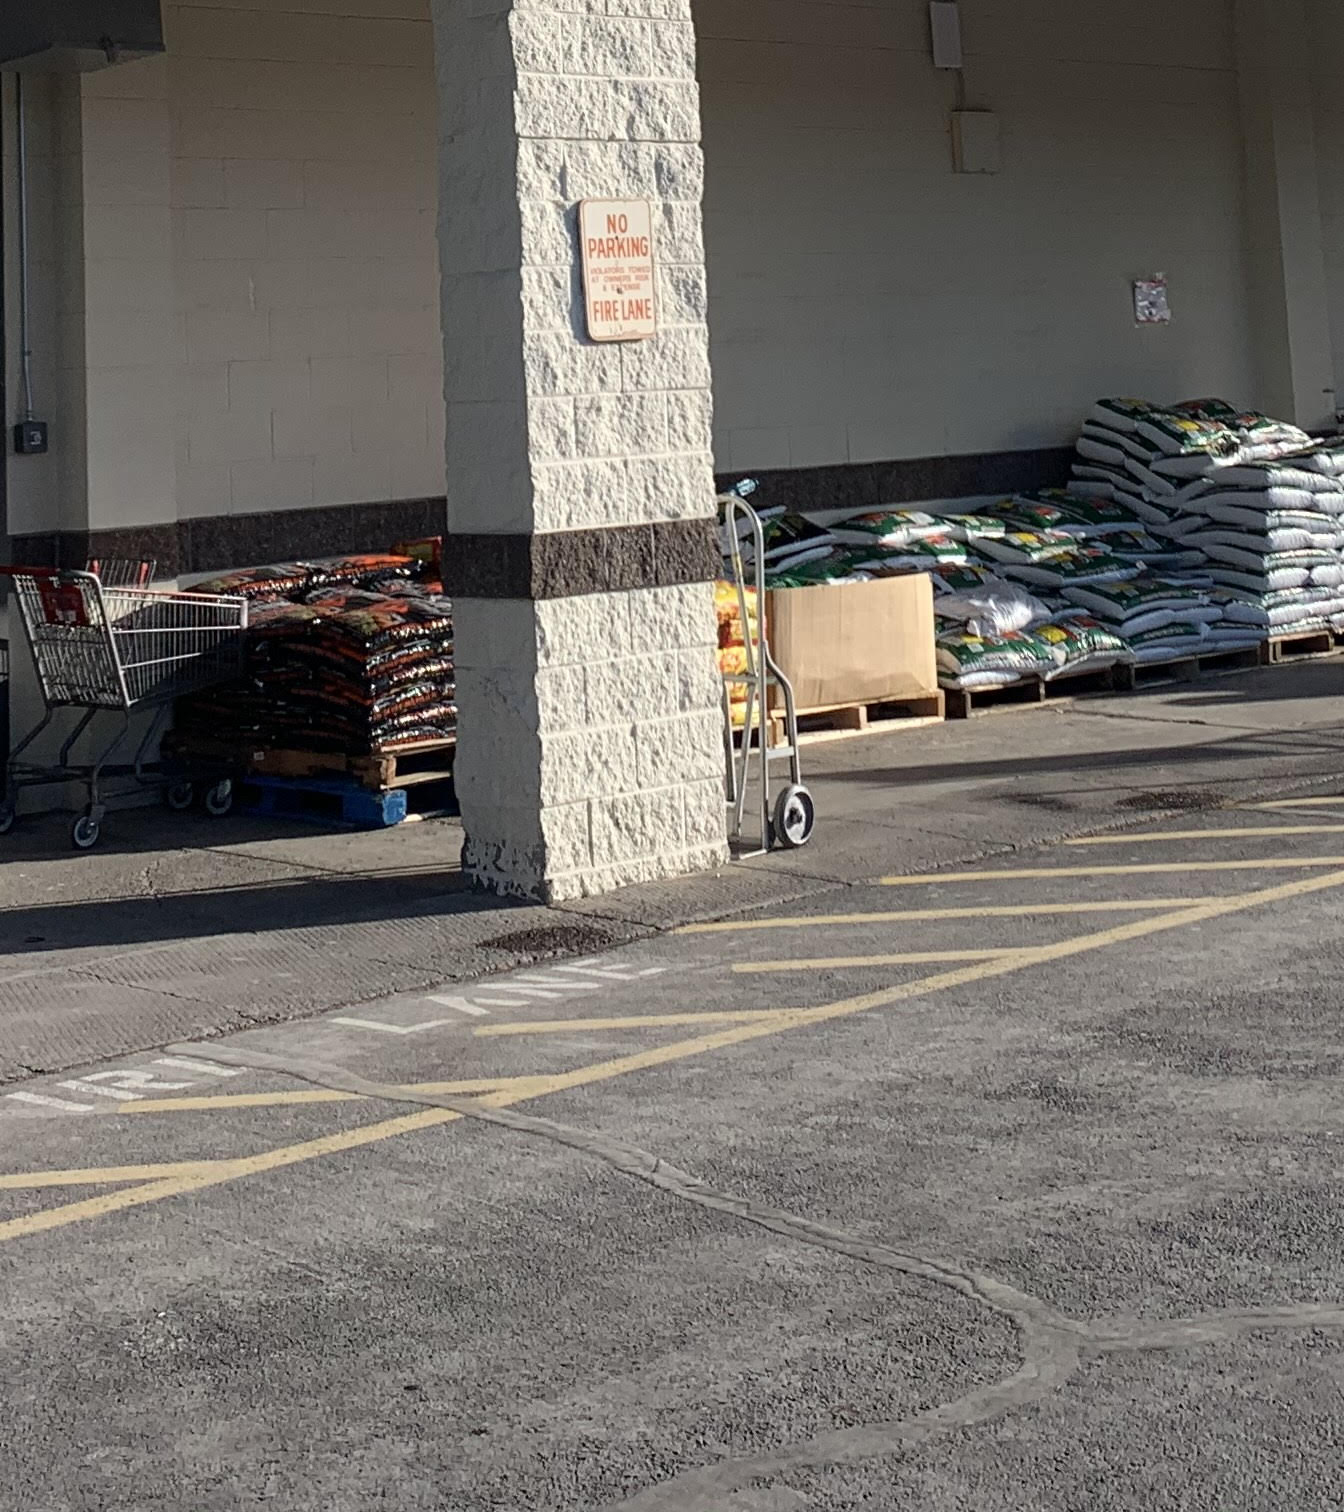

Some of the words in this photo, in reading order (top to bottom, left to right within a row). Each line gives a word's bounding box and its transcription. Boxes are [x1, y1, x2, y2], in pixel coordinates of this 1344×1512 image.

[607, 214, 628, 234] NO
[588, 236, 649, 259] PARKING
[593, 300, 619, 322] FIRE
[621, 298, 652, 321] LANE
[330, 958, 668, 1034] LANE
